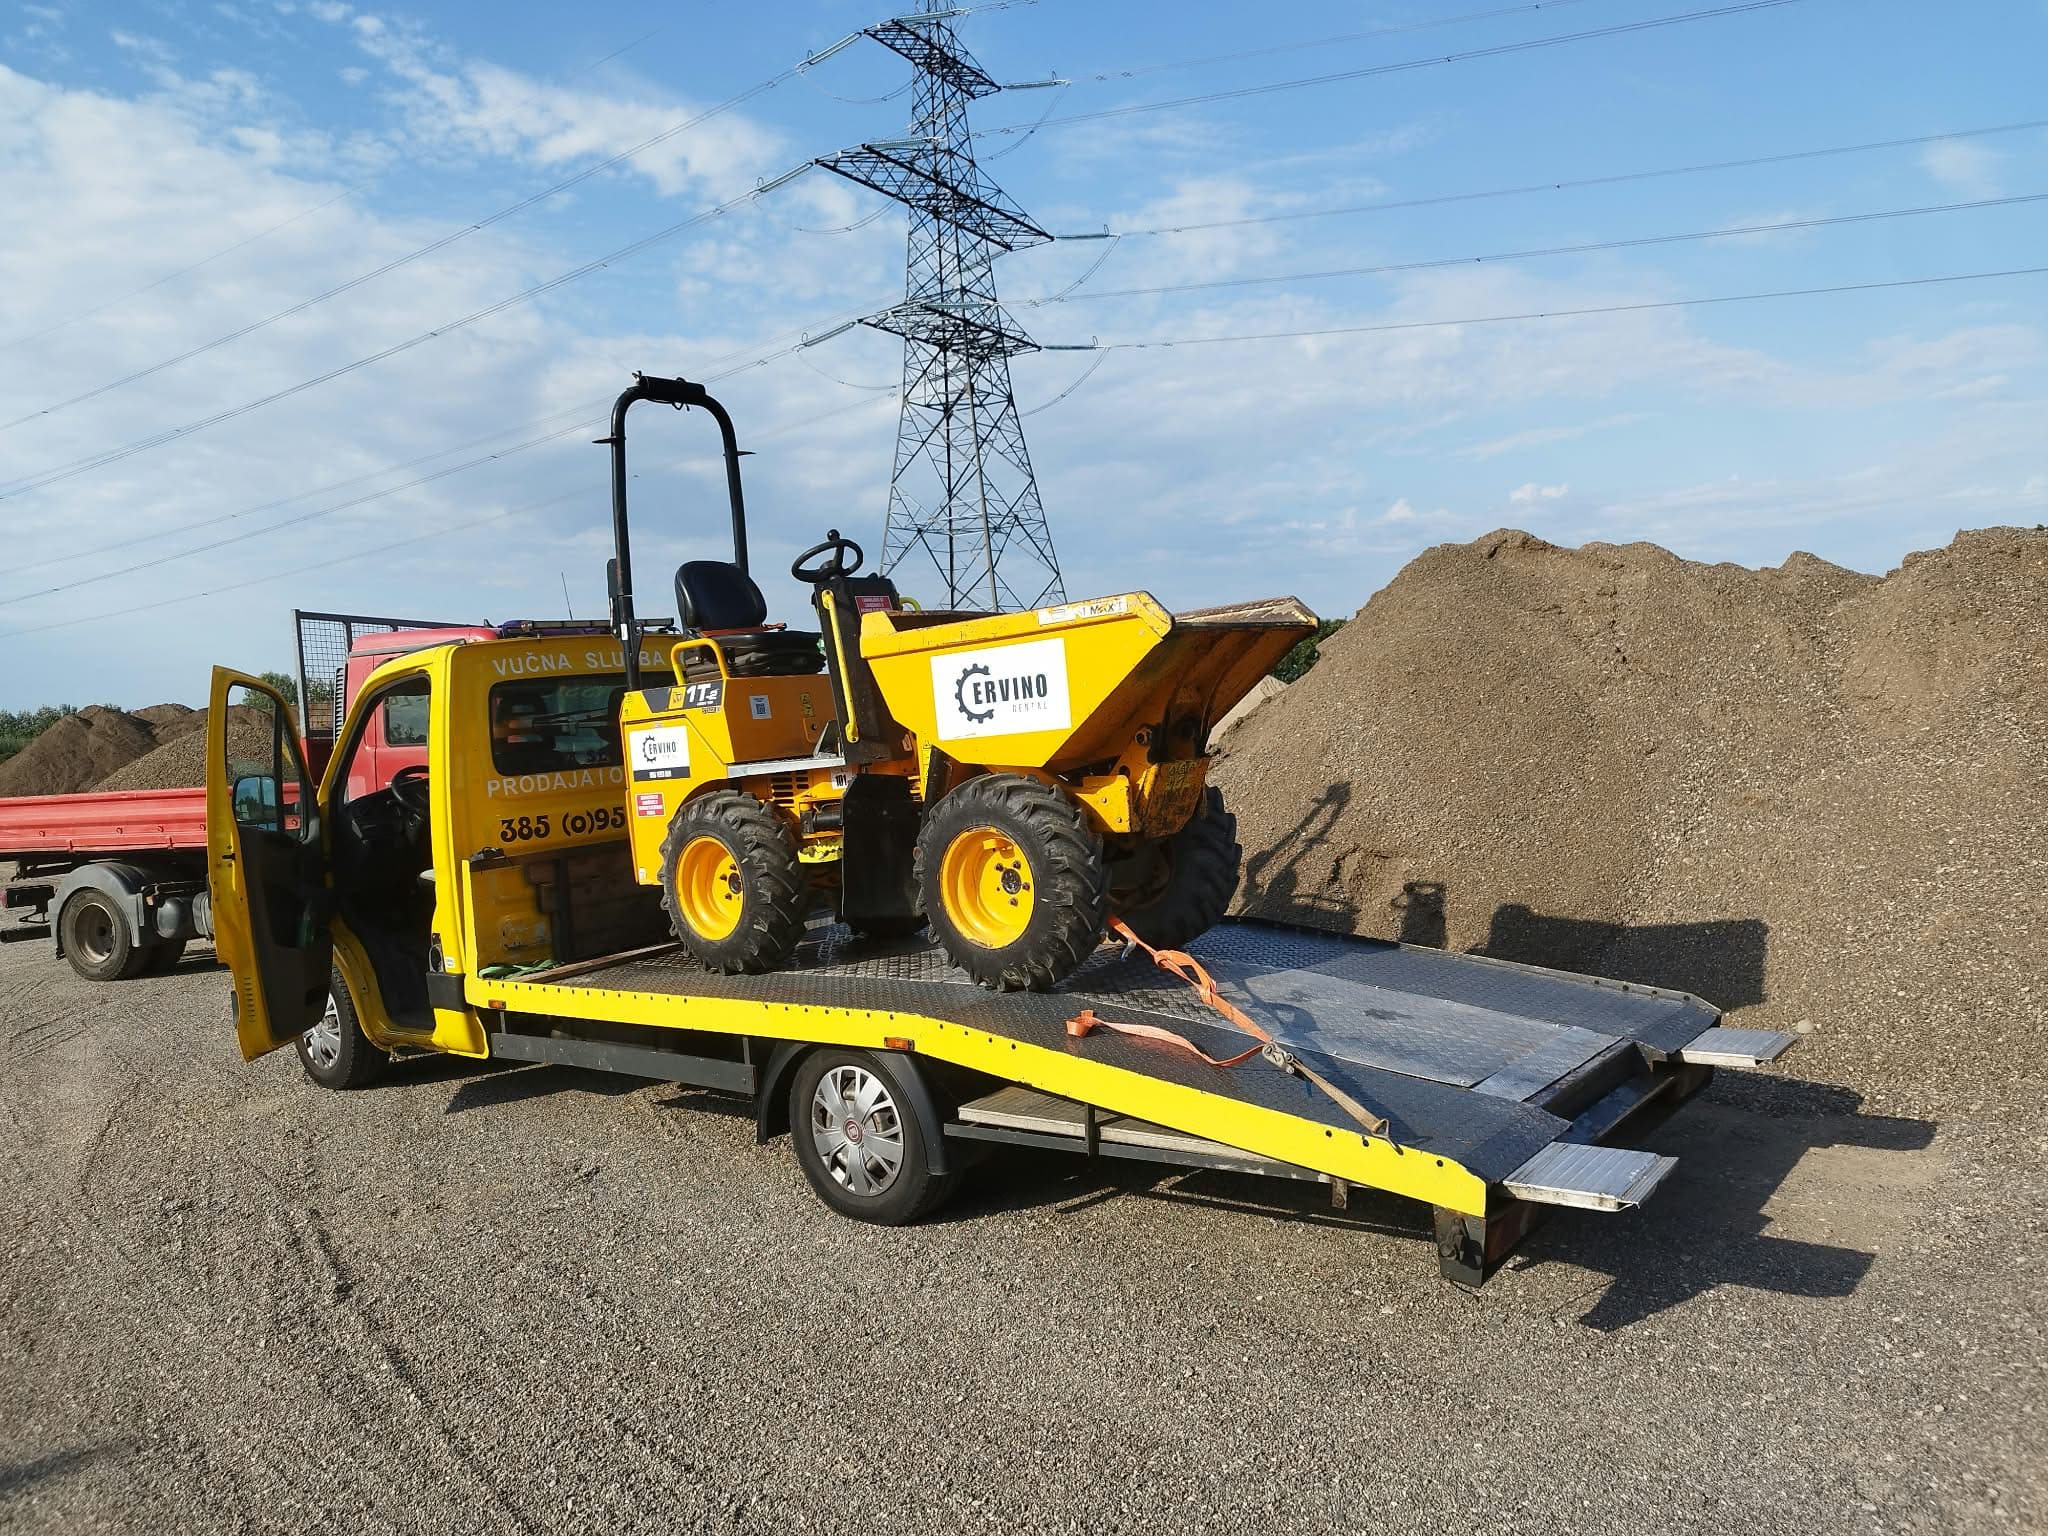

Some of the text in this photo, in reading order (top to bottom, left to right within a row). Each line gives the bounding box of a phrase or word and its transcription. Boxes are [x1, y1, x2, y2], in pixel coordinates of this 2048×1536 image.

[492, 651, 573, 677] VUČNA
[584, 650, 665, 669] SLUBA
[487, 768, 595, 799] PRODAJA
[500, 814, 551, 843] 385
